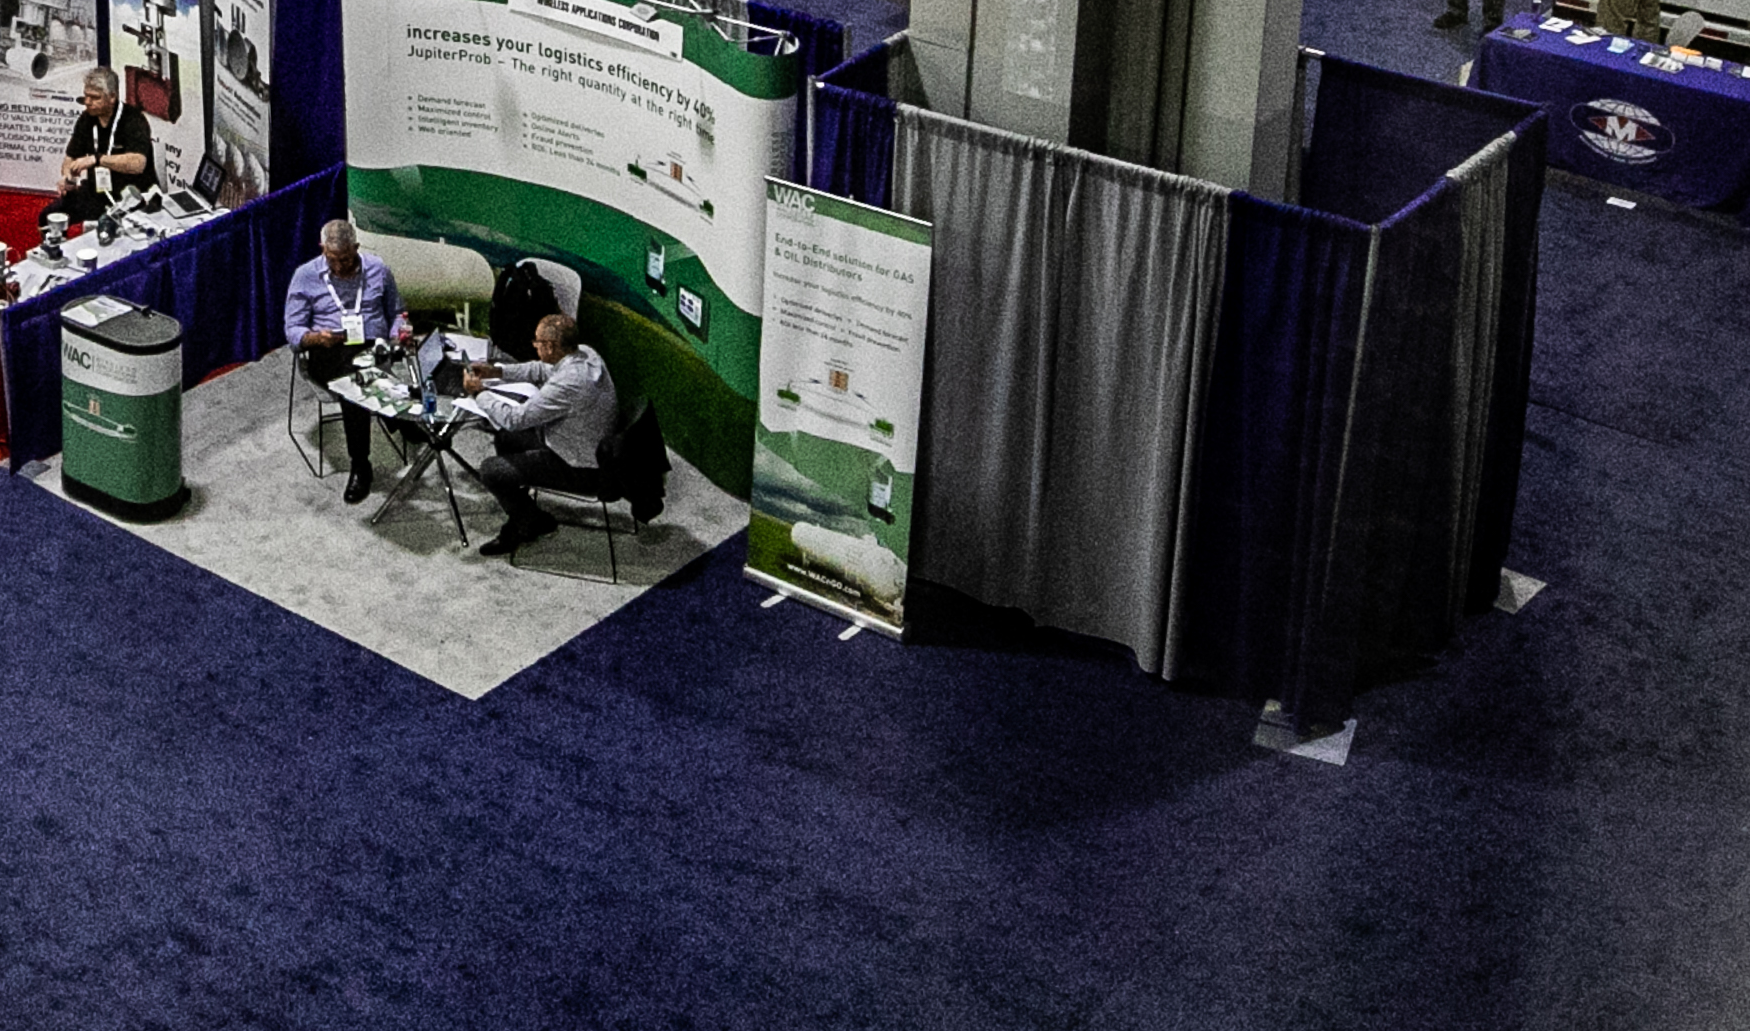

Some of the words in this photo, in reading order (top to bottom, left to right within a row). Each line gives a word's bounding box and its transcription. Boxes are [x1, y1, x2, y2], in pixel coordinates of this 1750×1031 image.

[571, 2, 617, 27] APPLICATIONS
[618, 15, 661, 42] CORPORATION
[406, 24, 492, 47] increases
[495, 36, 534, 54] your
[537, 41, 604, 72] logistics
[607, 62, 674, 103] efficiency
[677, 88, 692, 113] by
[692, 98, 716, 126] 40%
[406, 44, 493, 65] JupiterProb
[511, 57, 536, 75] The
[540, 65, 574, 85] right
[577, 74, 627, 102] quantity
[630, 92, 643, 109] at
[646, 96, 664, 117] the
[668, 108, 695, 134] right
[695, 119, 716, 145] time
[417, 94, 451, 105] Demand
[453, 98, 487, 110] forecast
[11, 103, 48, 114] RETURN
[11, 113, 38, 122] VALVE
[39, 116, 62, 125] SHUT
[417, 105, 462, 117] Maximized
[462, 109, 492, 120] control
[33, 125, 43, 133] IN
[417, 115, 460, 127] Intelligent
[461, 120, 499, 133] inventory
[417, 124, 436, 134] Web
[437, 127, 472, 138] oriented
[531, 111, 569, 128] Optimized
[570, 120, 605, 139] deliveries
[531, 122, 556, 135] Online
[557, 129, 581, 141] Alerts
[1604, 114, 1639, 142] M
[531, 132, 554, 145] Fraud
[555, 138, 594, 156] prevention
[23, 153, 43, 162] LINK
[549, 147, 567, 160] Less
[568, 151, 585, 163] than
[772, 184, 816, 212] WAC
[774, 247, 781, 257] &
[783, 250, 800, 264] OIL
[802, 255, 863, 282] Distributors
[775, 232, 831, 258] End-to-End
[832, 252, 873, 271] solution
[875, 263, 890, 277] for
[893, 269, 915, 285] GAS
[62, 342, 92, 370] WAC
